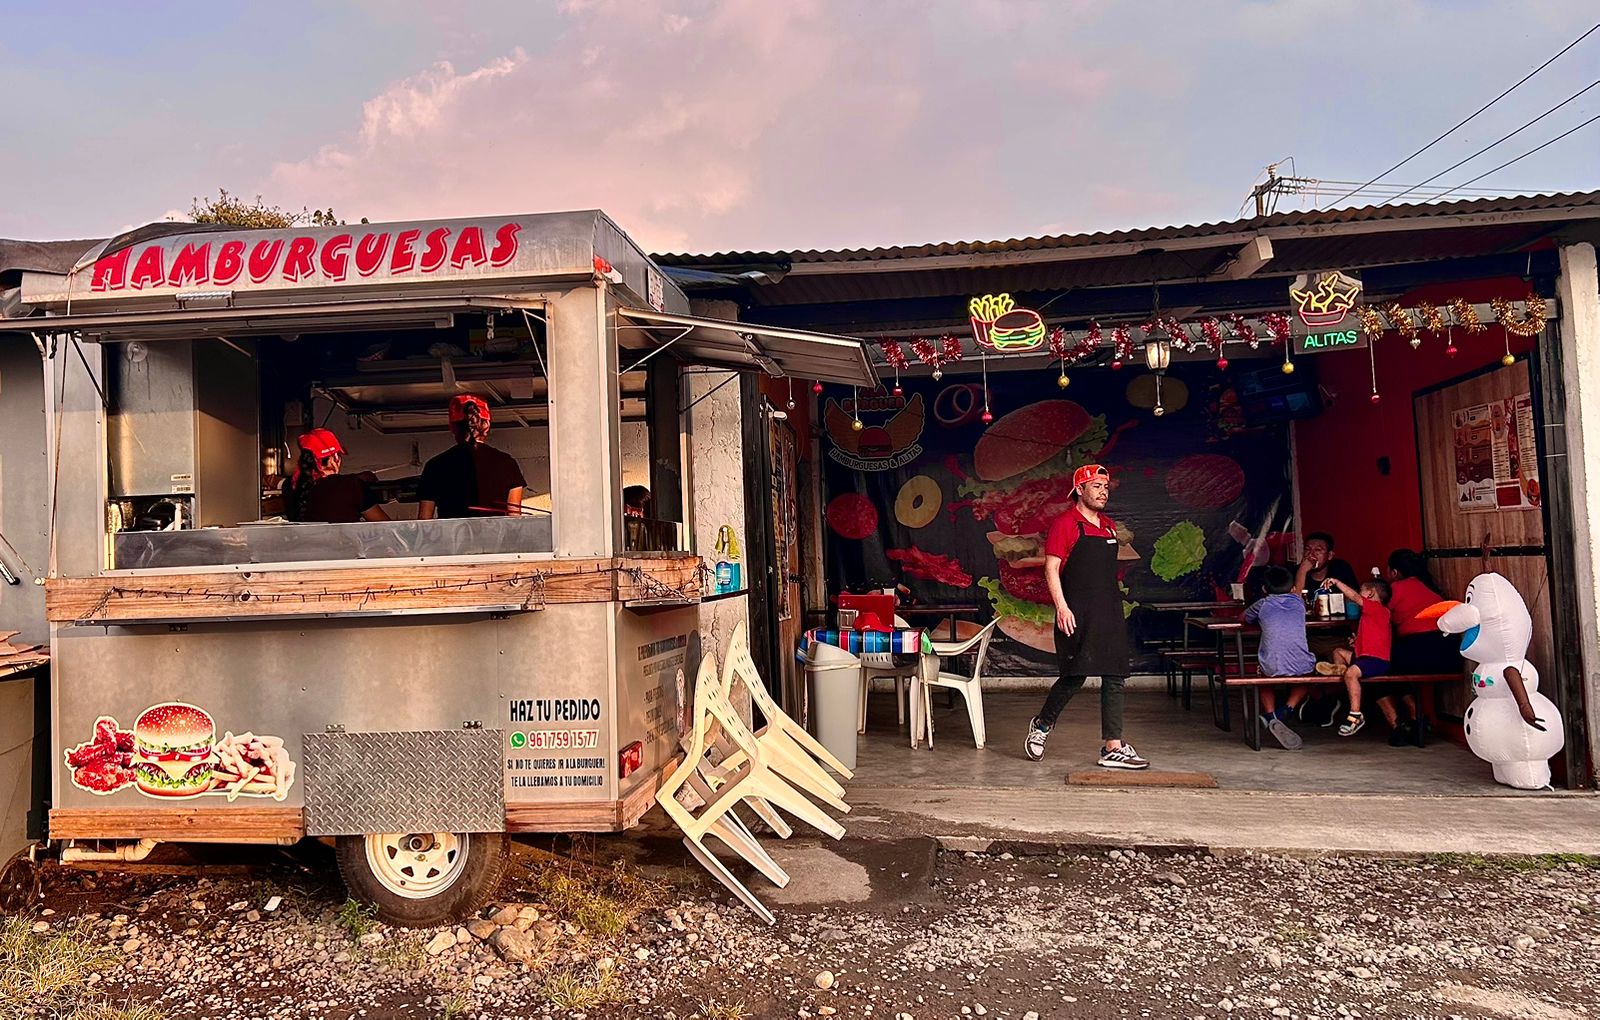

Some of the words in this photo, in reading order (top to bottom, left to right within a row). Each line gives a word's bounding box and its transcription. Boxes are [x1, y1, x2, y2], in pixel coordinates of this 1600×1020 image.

[90, 222, 521, 292] HAMBURGUESAS
[1304, 330, 1357, 349] ALITAS
[830, 447, 888, 470] HAMBURGUESAS
[889, 459, 898, 468] &
[899, 444, 922, 465] ALITAS
[510, 700, 534, 721] HAZ
[536, 699, 551, 721] TU
[555, 698, 600, 721] PEDIDO
[529, 731, 547, 747] 961
[550, 731, 569, 747] 759
[507, 759, 514, 769] SI
[515, 759, 524, 769] NO
[525, 759, 532, 769] TE
[533, 758, 556, 769] QUIERES
[511, 776, 518, 787] TE
[519, 776, 526, 787] LA
[565, 776, 572, 786] TU
[573, 775, 603, 786] DOMICILIO
